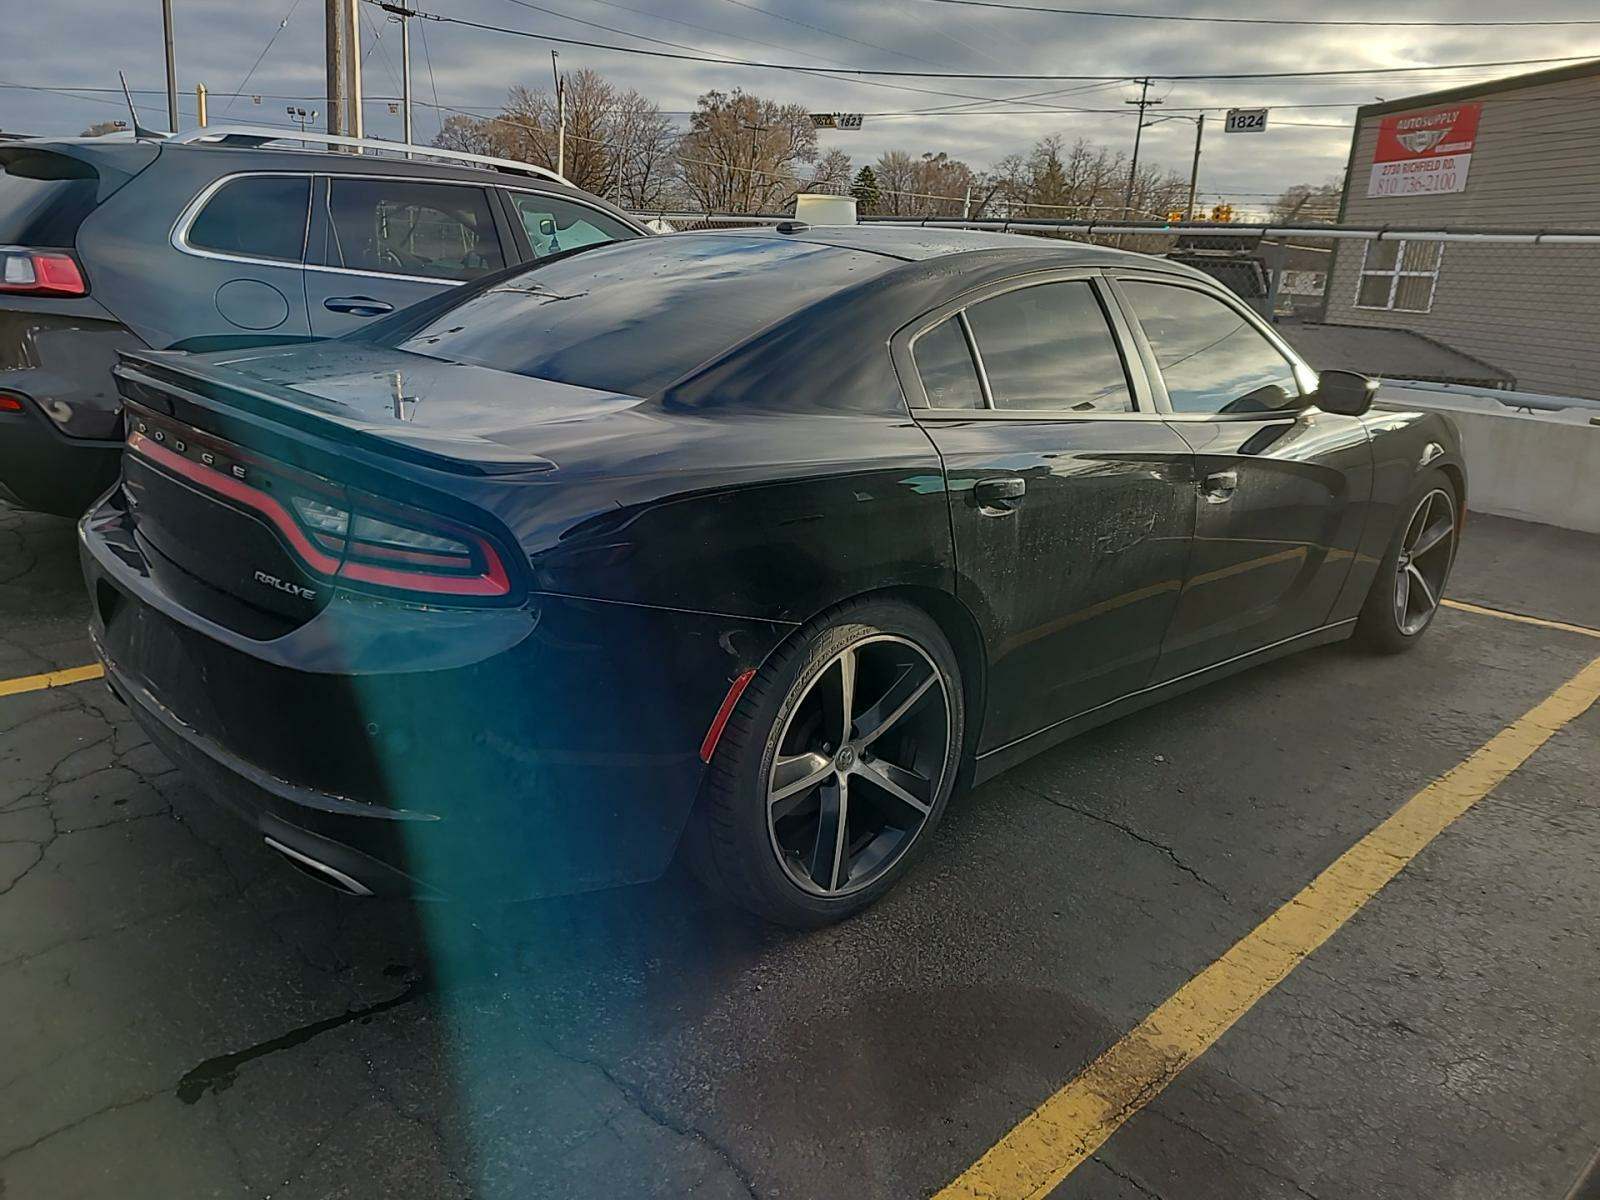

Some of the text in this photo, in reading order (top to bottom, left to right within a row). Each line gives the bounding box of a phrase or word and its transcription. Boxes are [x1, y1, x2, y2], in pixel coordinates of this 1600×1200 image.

[840, 117, 862, 127] 1823
[1230, 115, 1264, 128] 1824
[1396, 111, 1460, 130] AUTOSUPPLY
[1377, 173, 1456, 194] 810 736-2100
[138, 423, 246, 478] DODGE
[254, 571, 316, 600] RALLYE
